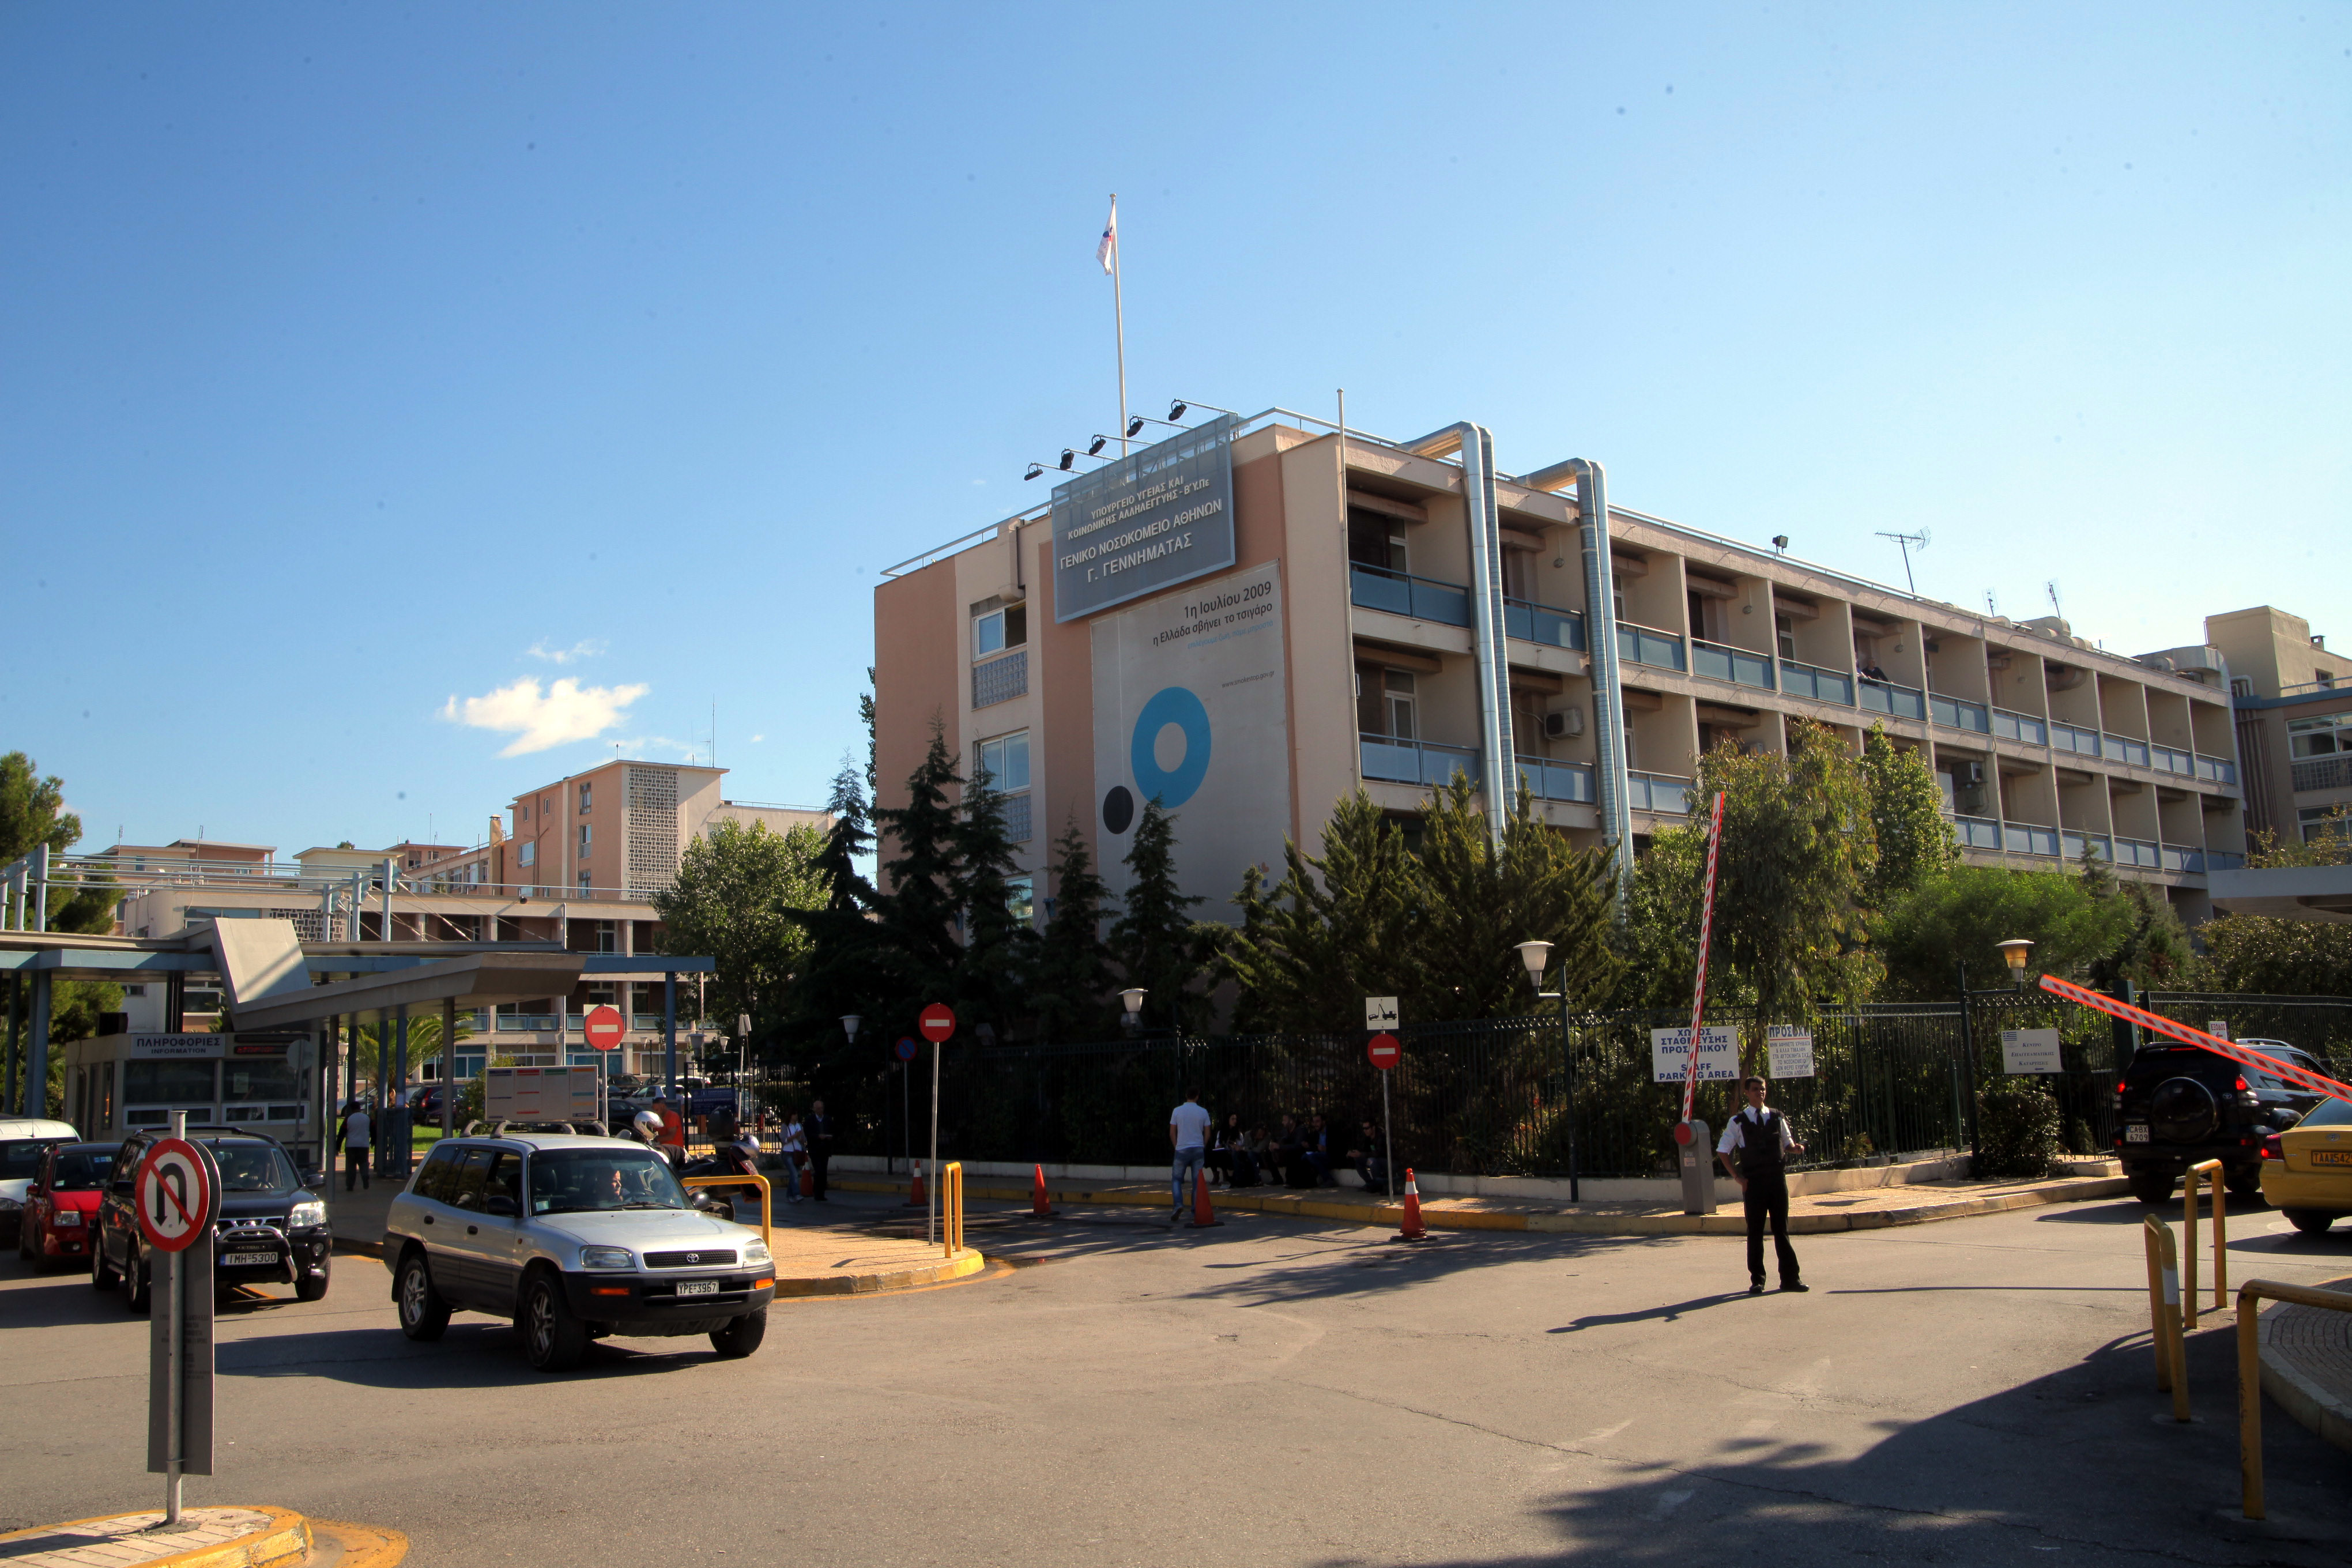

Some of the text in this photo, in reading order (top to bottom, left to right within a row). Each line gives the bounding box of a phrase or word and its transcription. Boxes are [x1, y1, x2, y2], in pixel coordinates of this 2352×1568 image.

[1091, 475, 1183, 519] ΥΠΟΥΡΓΕΙΟ ΥΓΕΙΑΣ ΚΑΙ
[1068, 515, 1116, 540] ΚΟΙΝΩΝΙΚΗΣ
[1119, 489, 1178, 520] ΑΛΛΗΛΕΓΓΥΗΣ
[1060, 498, 1223, 570] ΓΕΝΙΚΟ ΝΟΣΟΚΟΜΕΙΟ ΑΘΗΝΩΝ
[1087, 532, 1193, 583] Γ. ΓΕΝΝΗΜΑΤΑΣ
[1184, 581, 1272, 619] 1η Ιουλίου 2009
[1153, 603, 1273, 647] η Ελλάδα σβήνει το τσιγάρο
[1222, 670, 1275, 688] www.smokestop.gov.gr
[137, 1038, 220, 1047] ΠΛΗΡΟΦΟΡΙΕΣ
[1678, 1028, 1712, 1036] ΧΩΟΣ
[1661, 1044, 1728, 1054] ΠΡΟΣΠΙΚΟΥ
[1659, 1070, 1735, 1080] PARKG AREA
[1681, 1063, 1712, 1072] SAFF
